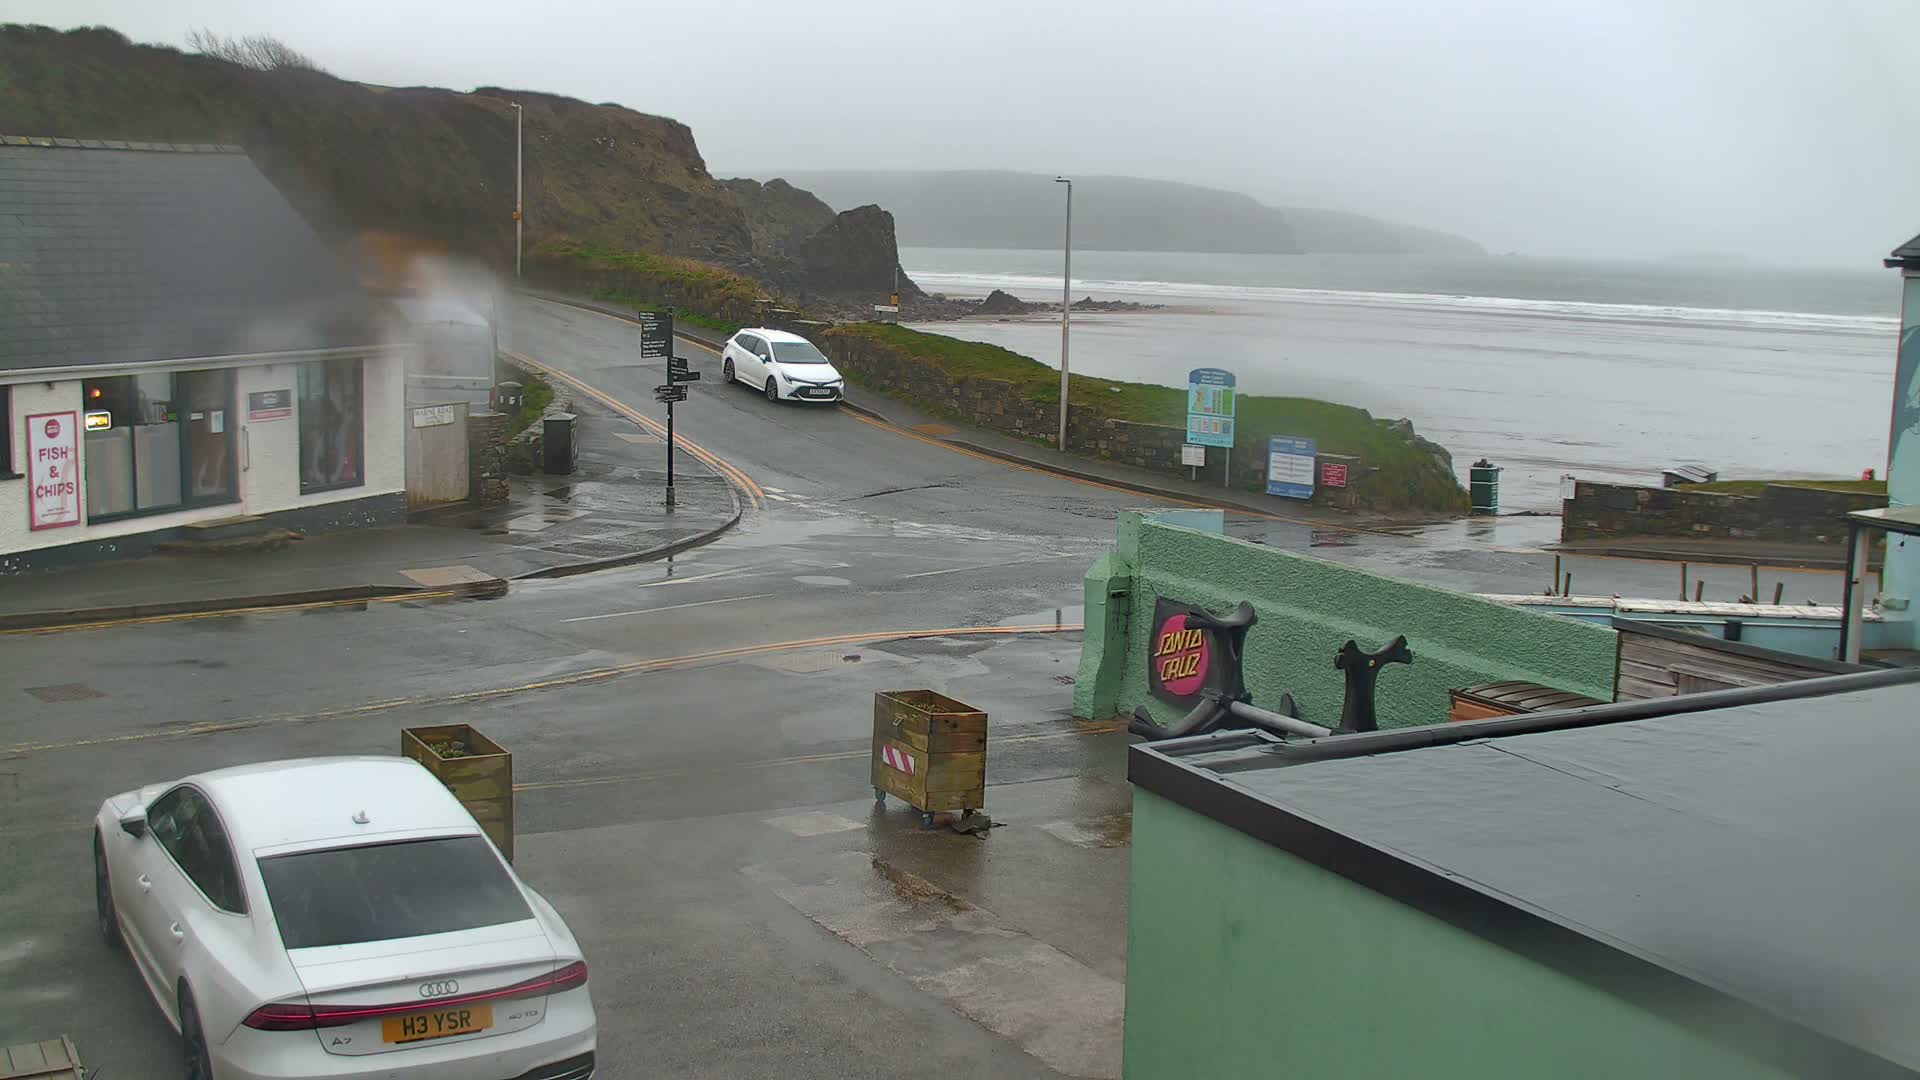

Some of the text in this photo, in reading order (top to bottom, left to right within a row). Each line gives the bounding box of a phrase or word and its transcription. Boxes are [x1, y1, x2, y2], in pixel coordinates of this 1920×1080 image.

[437, 405, 453, 414] ROAD
[39, 446, 69, 461] FISH
[49, 465, 60, 478] &
[36, 482, 74, 498] CHIPS
[1154, 628, 1203, 656] SANTA
[1161, 652, 1201, 681] CRUZ
[402, 1010, 471, 1036] H3 YSR
[331, 1036, 352, 1046] A7
